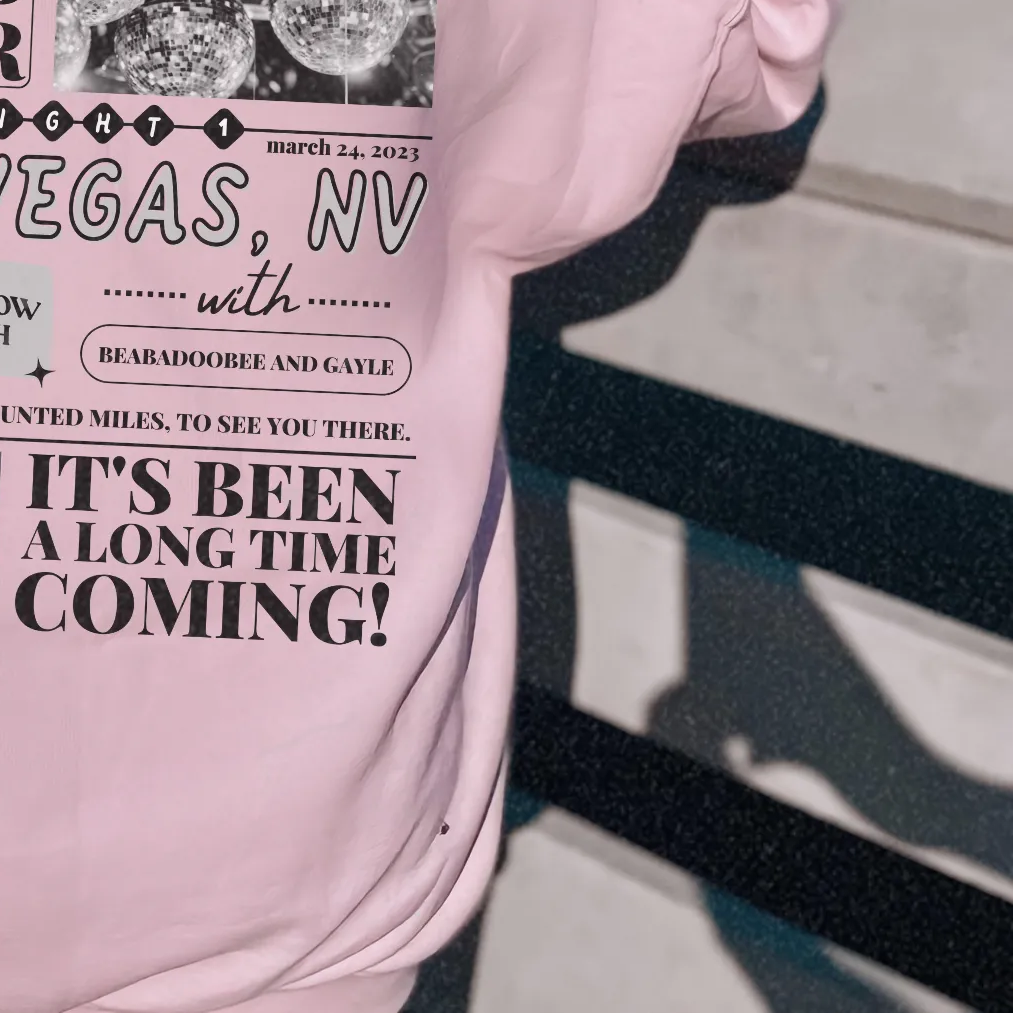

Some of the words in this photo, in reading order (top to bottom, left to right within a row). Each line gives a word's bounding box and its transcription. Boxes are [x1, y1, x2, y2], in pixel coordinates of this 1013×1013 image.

[218, 118, 228, 137] 1
[267, 139, 330, 155] march
[337, 144, 365, 160] 24,
[371, 146, 419, 162] 2023
[308, 168, 427, 255] NV
[197, 259, 300, 316] with
[99, 347, 265, 370] BEABADOOBEE
[270, 355, 317, 372] AND
[323, 357, 393, 375] GAYLE
[90, 410, 170, 433] MILES,
[177, 414, 211, 432] TO
[218, 415, 260, 434] SEE
[267, 418, 317, 437] YOU
[323, 420, 410, 441] THERE.
[26, 454, 171, 515] IT'S
[191, 460, 402, 526] BEEN
[21, 520, 61, 560] A
[74, 522, 235, 568] LONG
[250, 530, 396, 576] TIME
[15, 572, 390, 646] COMING!
